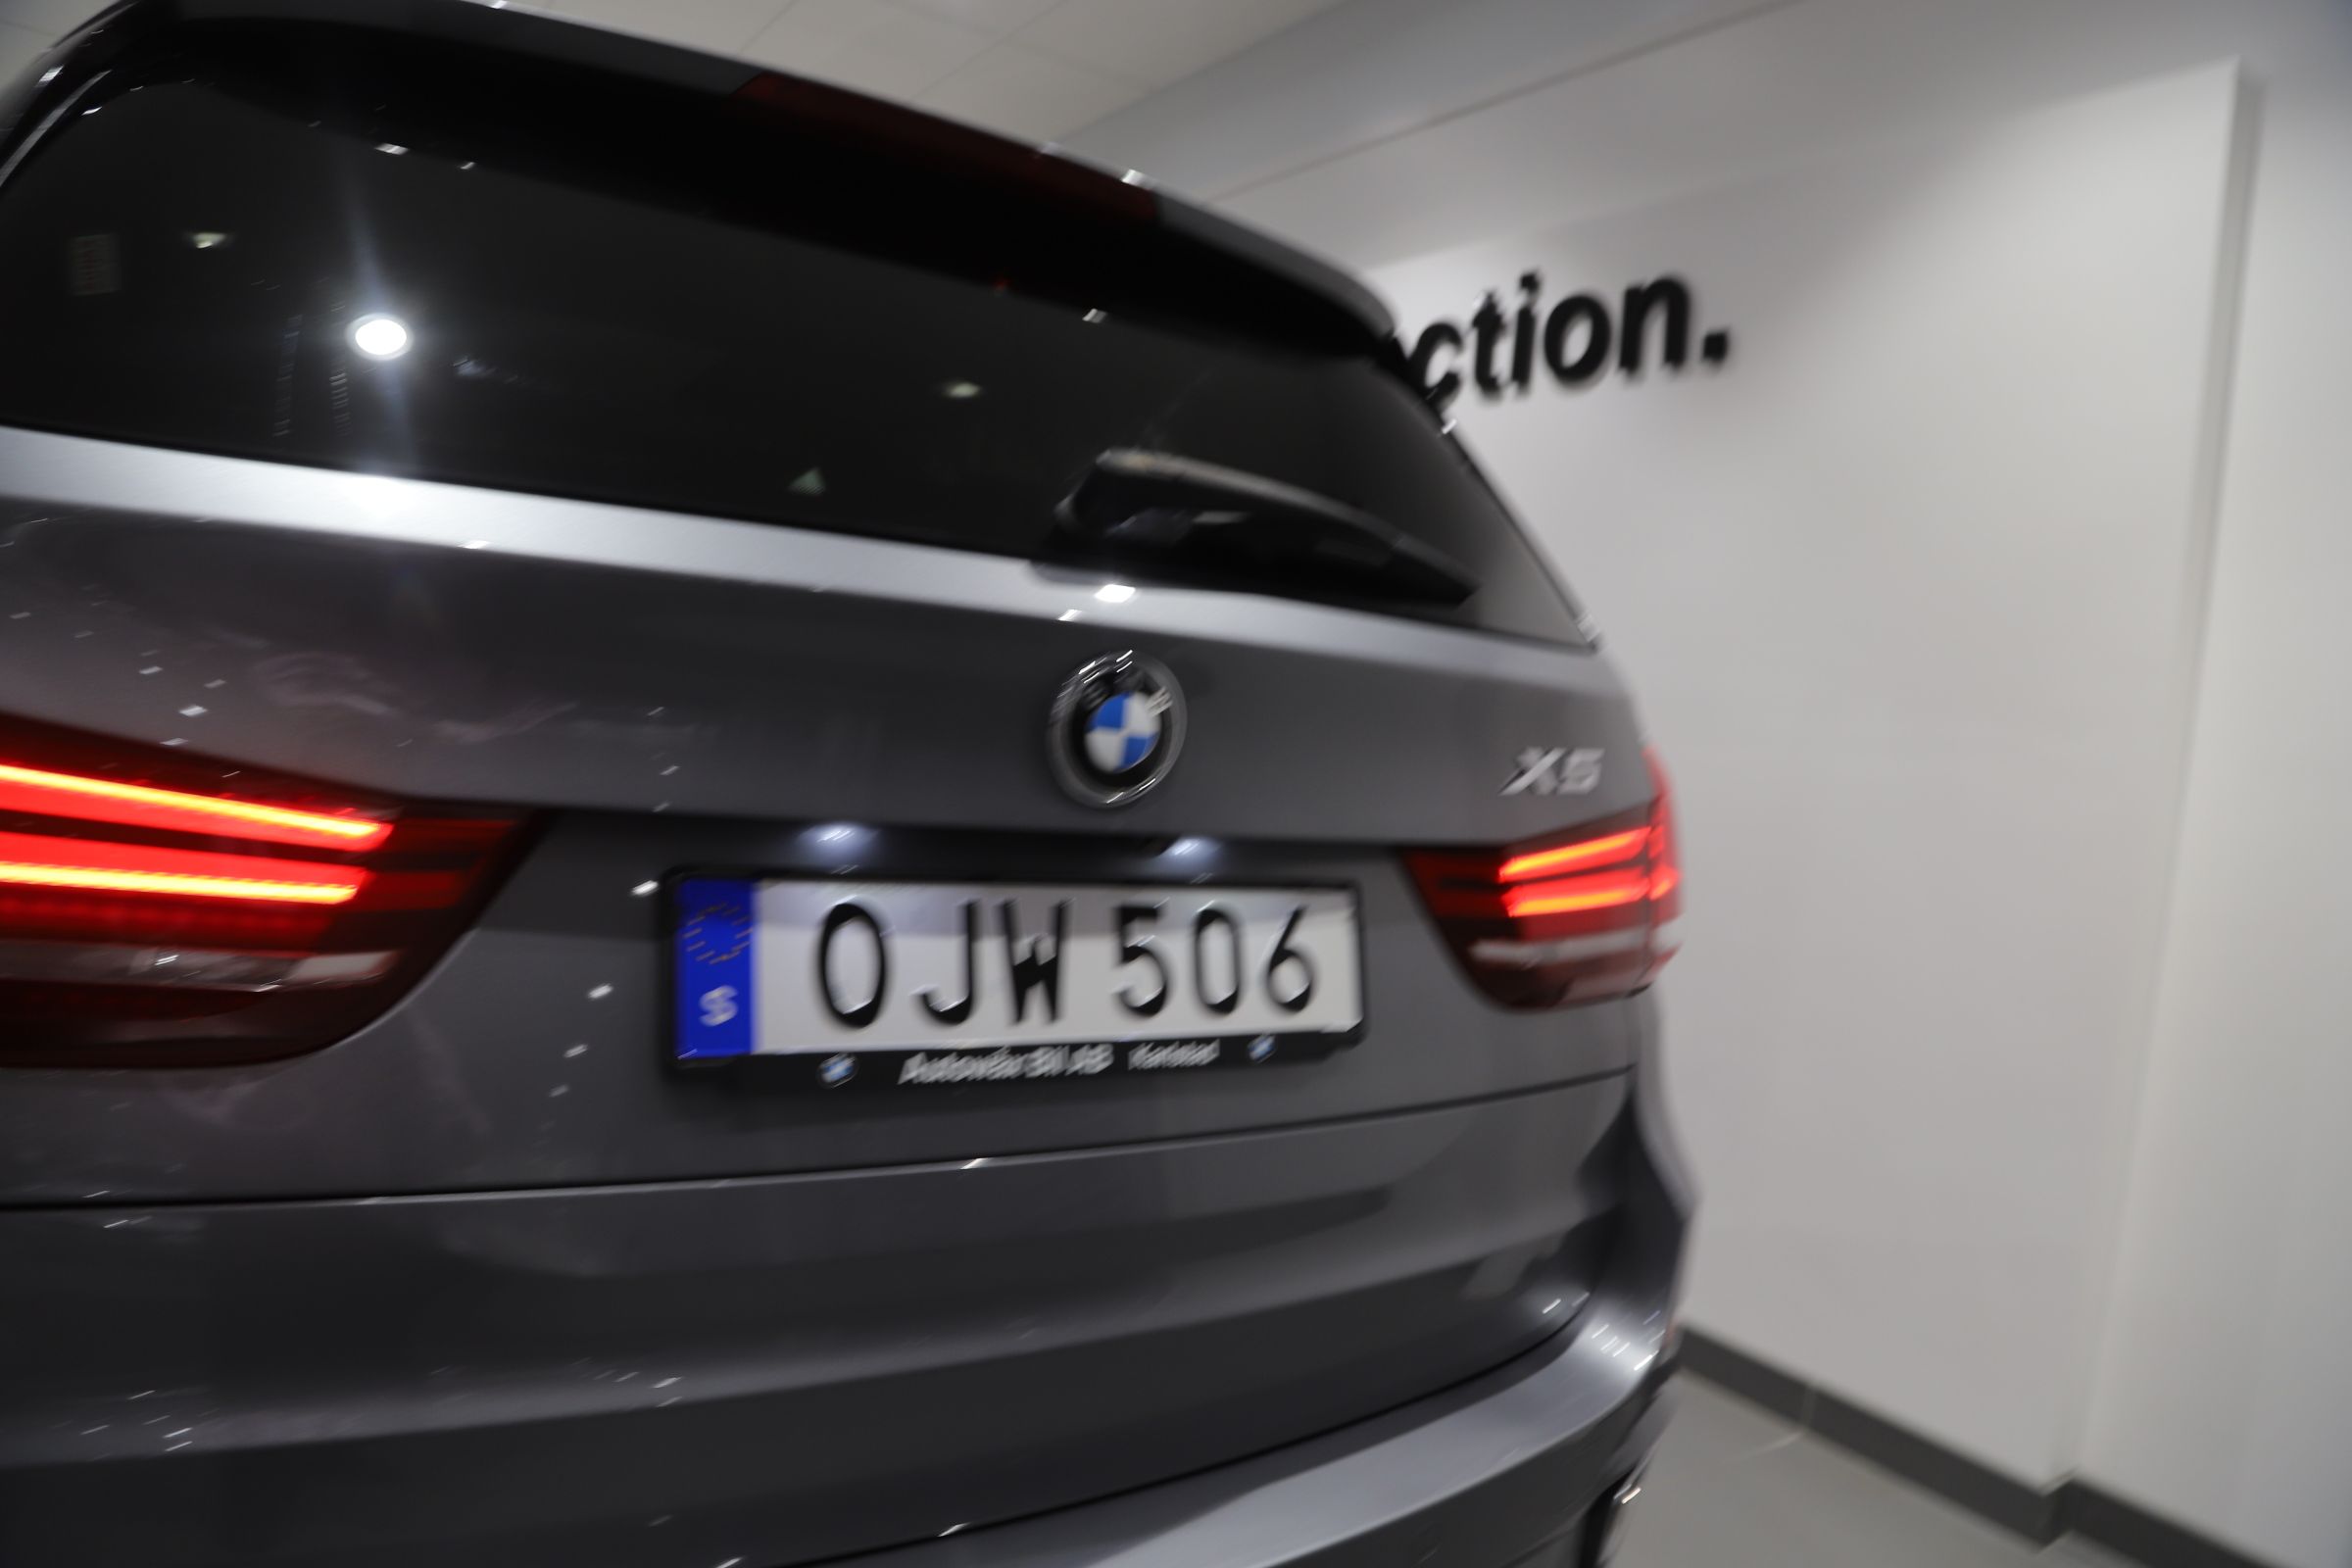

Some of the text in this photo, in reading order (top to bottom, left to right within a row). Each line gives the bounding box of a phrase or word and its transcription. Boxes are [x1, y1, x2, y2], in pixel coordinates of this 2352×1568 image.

[1499, 746, 1604, 797] X5
[817, 897, 1315, 1029] OJW 506
[699, 985, 738, 1026] S
